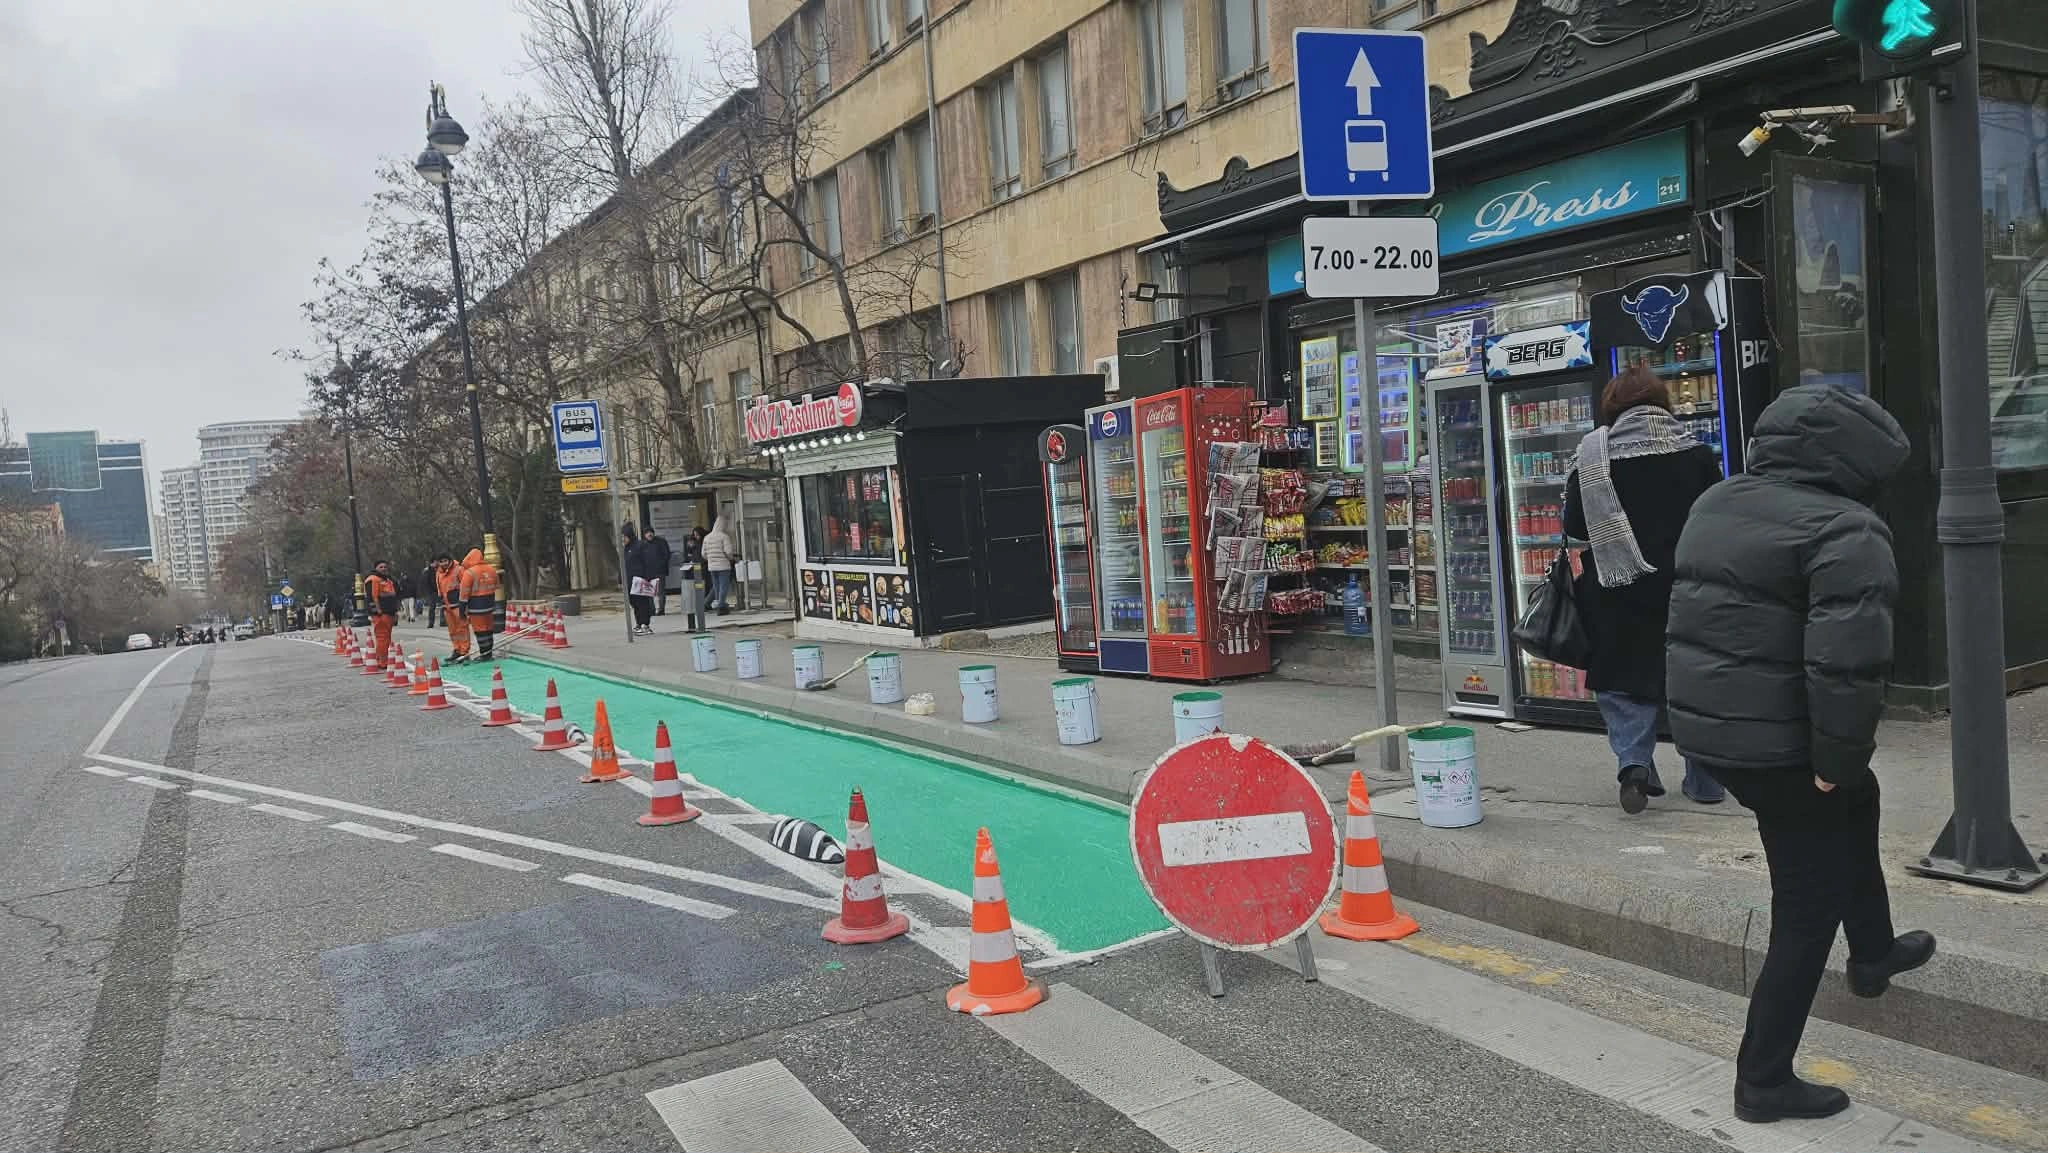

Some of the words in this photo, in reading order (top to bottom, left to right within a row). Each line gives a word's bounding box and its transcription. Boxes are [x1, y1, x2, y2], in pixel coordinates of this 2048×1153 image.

[1660, 182, 1680, 196] 211
[1467, 181, 1638, 243] Press
[1502, 337, 1570, 365] BERG
[565, 409, 586, 417] BUS
[746, 399, 779, 441] KÖZ
